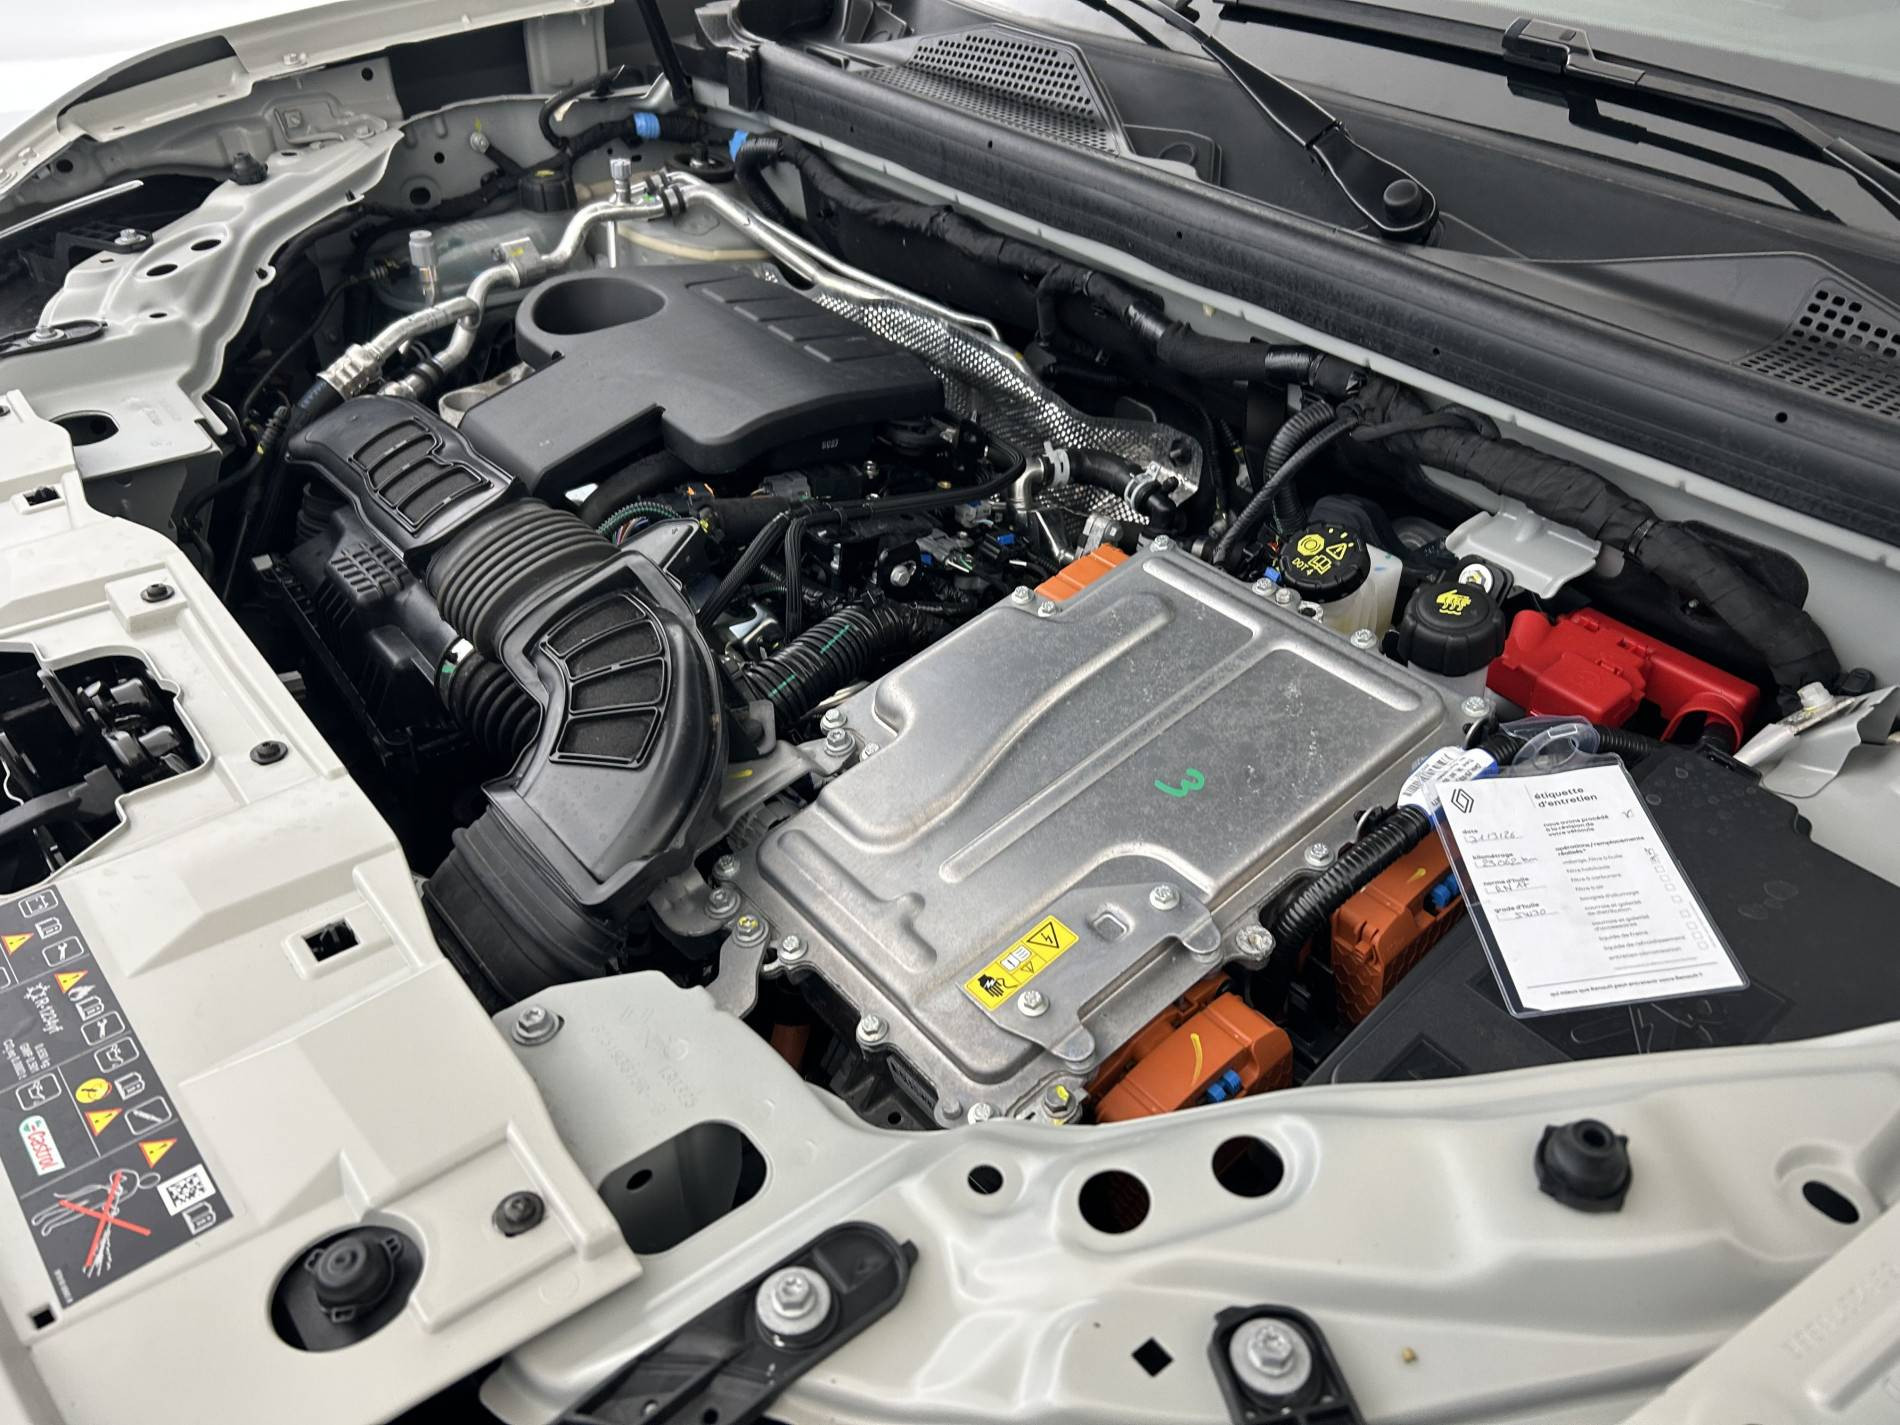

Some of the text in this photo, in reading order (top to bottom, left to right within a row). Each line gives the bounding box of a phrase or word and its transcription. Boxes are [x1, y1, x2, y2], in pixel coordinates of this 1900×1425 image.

[1292, 557, 1308, 571] DOT
[1534, 787, 1584, 800] étiquette
[1538, 793, 1598, 808] d'entretien
[28, 1131, 59, 1170] Castrol
